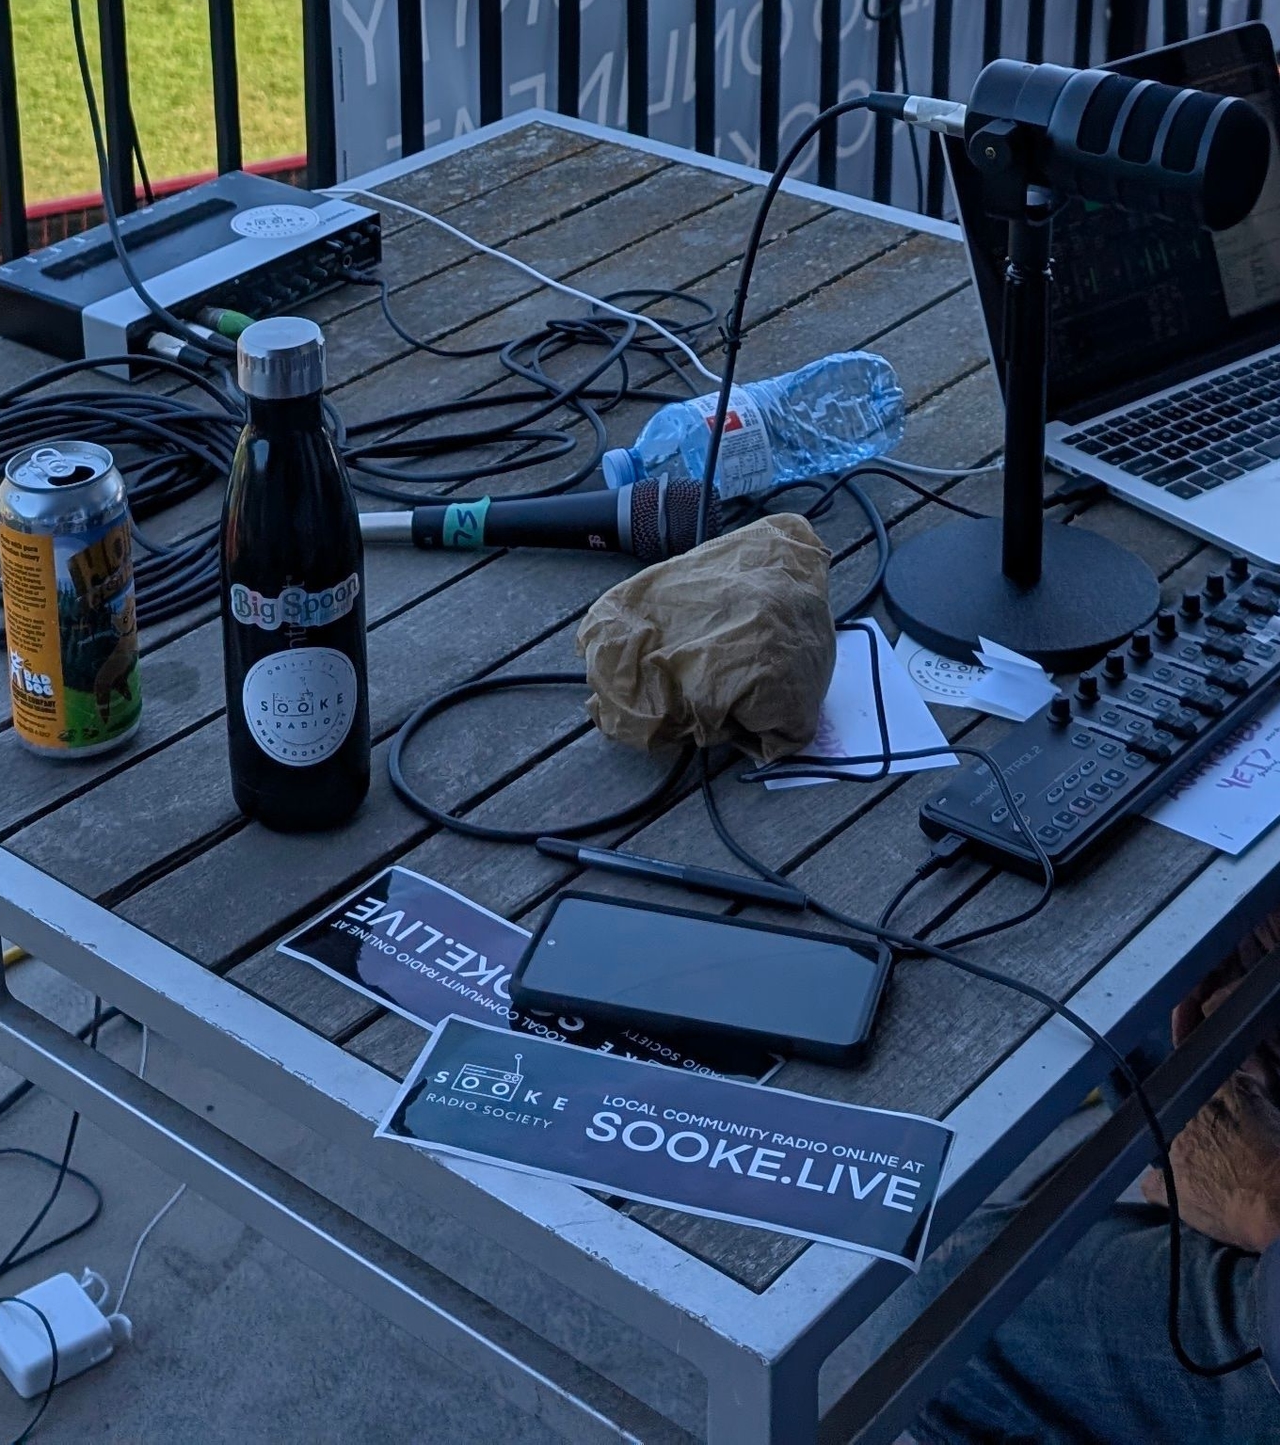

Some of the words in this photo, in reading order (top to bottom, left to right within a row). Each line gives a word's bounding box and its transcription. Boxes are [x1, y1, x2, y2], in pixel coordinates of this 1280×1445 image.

[234, 588, 275, 624] Big
[283, 577, 358, 622] Spoon
[24, 669, 52, 685] BAD
[25, 681, 55, 697] DOG
[260, 692, 344, 714] SOOKE
[276, 717, 331, 730] RADIO
[331, 919, 349, 931] AT
[347, 926, 398, 955] ONLINE
[396, 952, 443, 980] RADIO
[436, 976, 520, 1021] COMMUNITY
[521, 1016, 568, 1044] LOCAL
[620, 1028, 682, 1061] SOCIETY
[434, 1070, 570, 1112] SOOKE
[426, 1092, 478, 1111] RADIO
[482, 1105, 554, 1129] SOCIETY
[602, 1094, 658, 1117] LOCAL
[663, 1108, 770, 1141] COMMUNITY
[771, 1132, 828, 1154] RADIO
[832, 1145, 900, 1169] ONLINE
[901, 1160, 926, 1175] AT
[585, 1111, 922, 1214] SOOKE.LIVE
